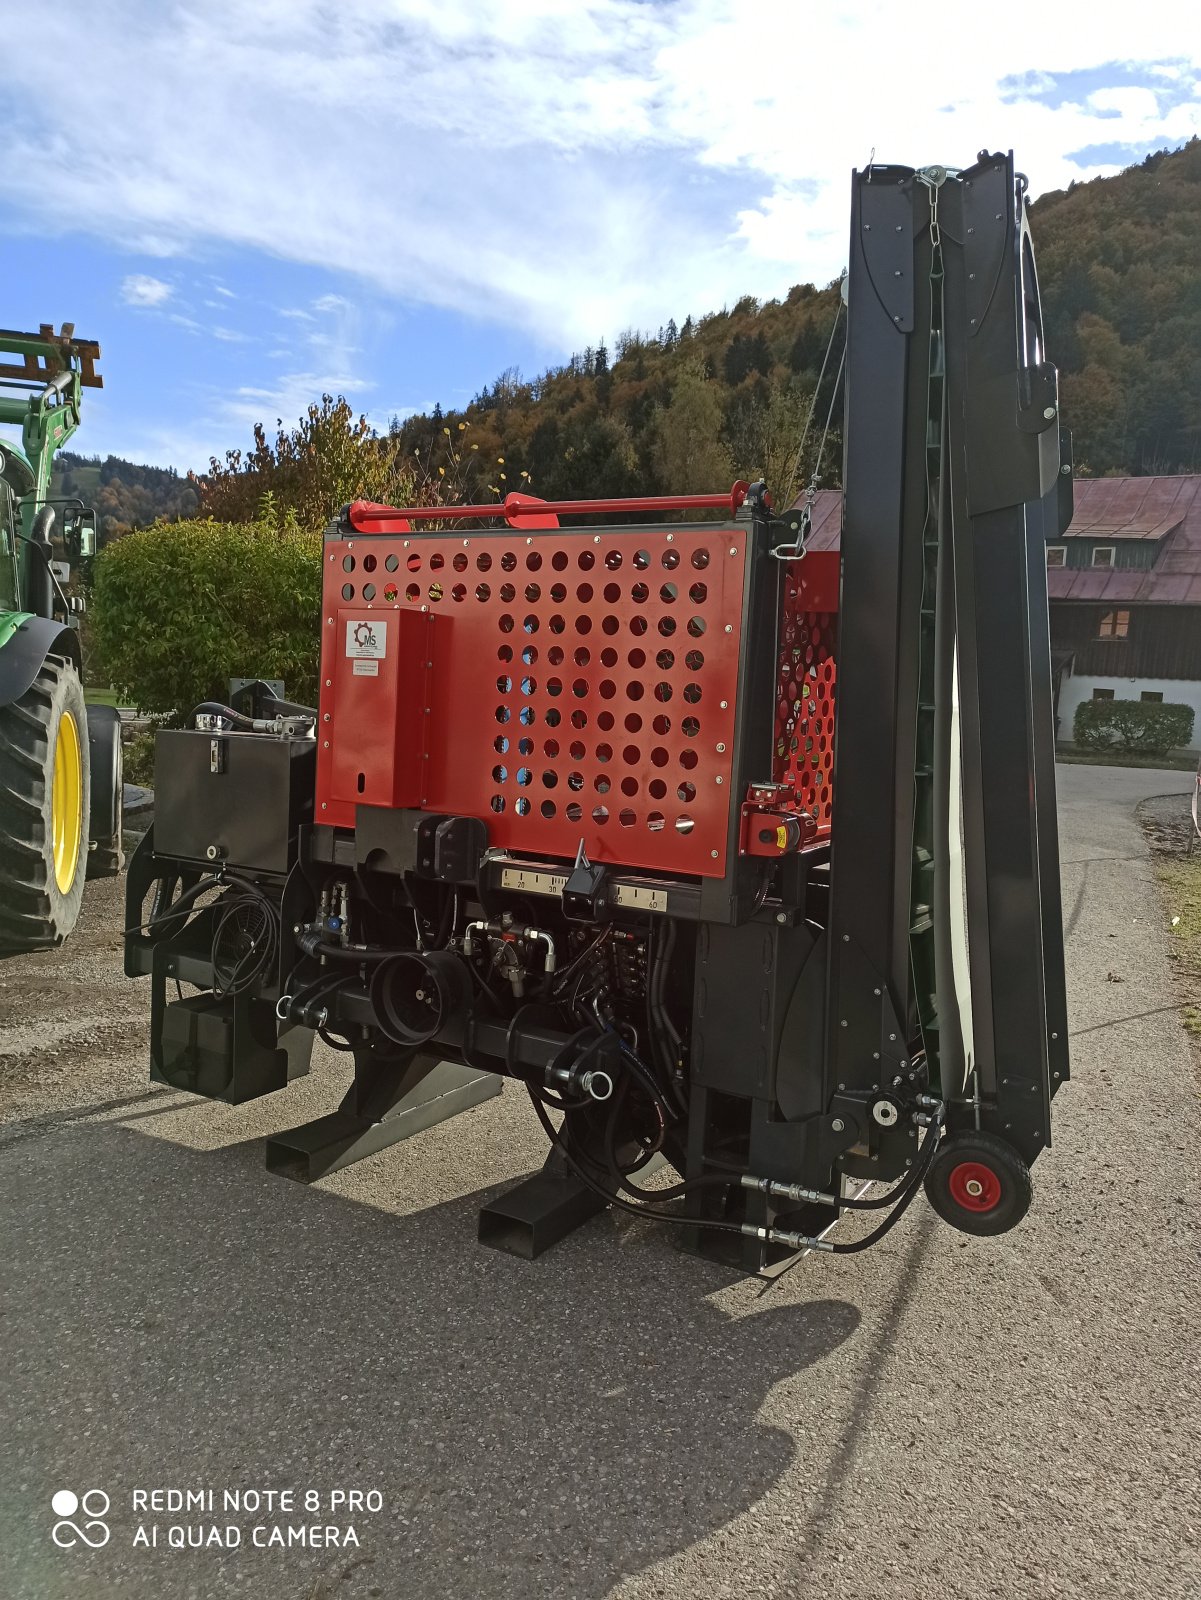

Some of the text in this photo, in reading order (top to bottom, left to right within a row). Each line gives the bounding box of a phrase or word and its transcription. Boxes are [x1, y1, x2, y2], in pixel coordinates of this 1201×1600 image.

[517, 881, 525, 889] 20
[548, 885, 557, 893] 30
[648, 901, 658, 909] 60
